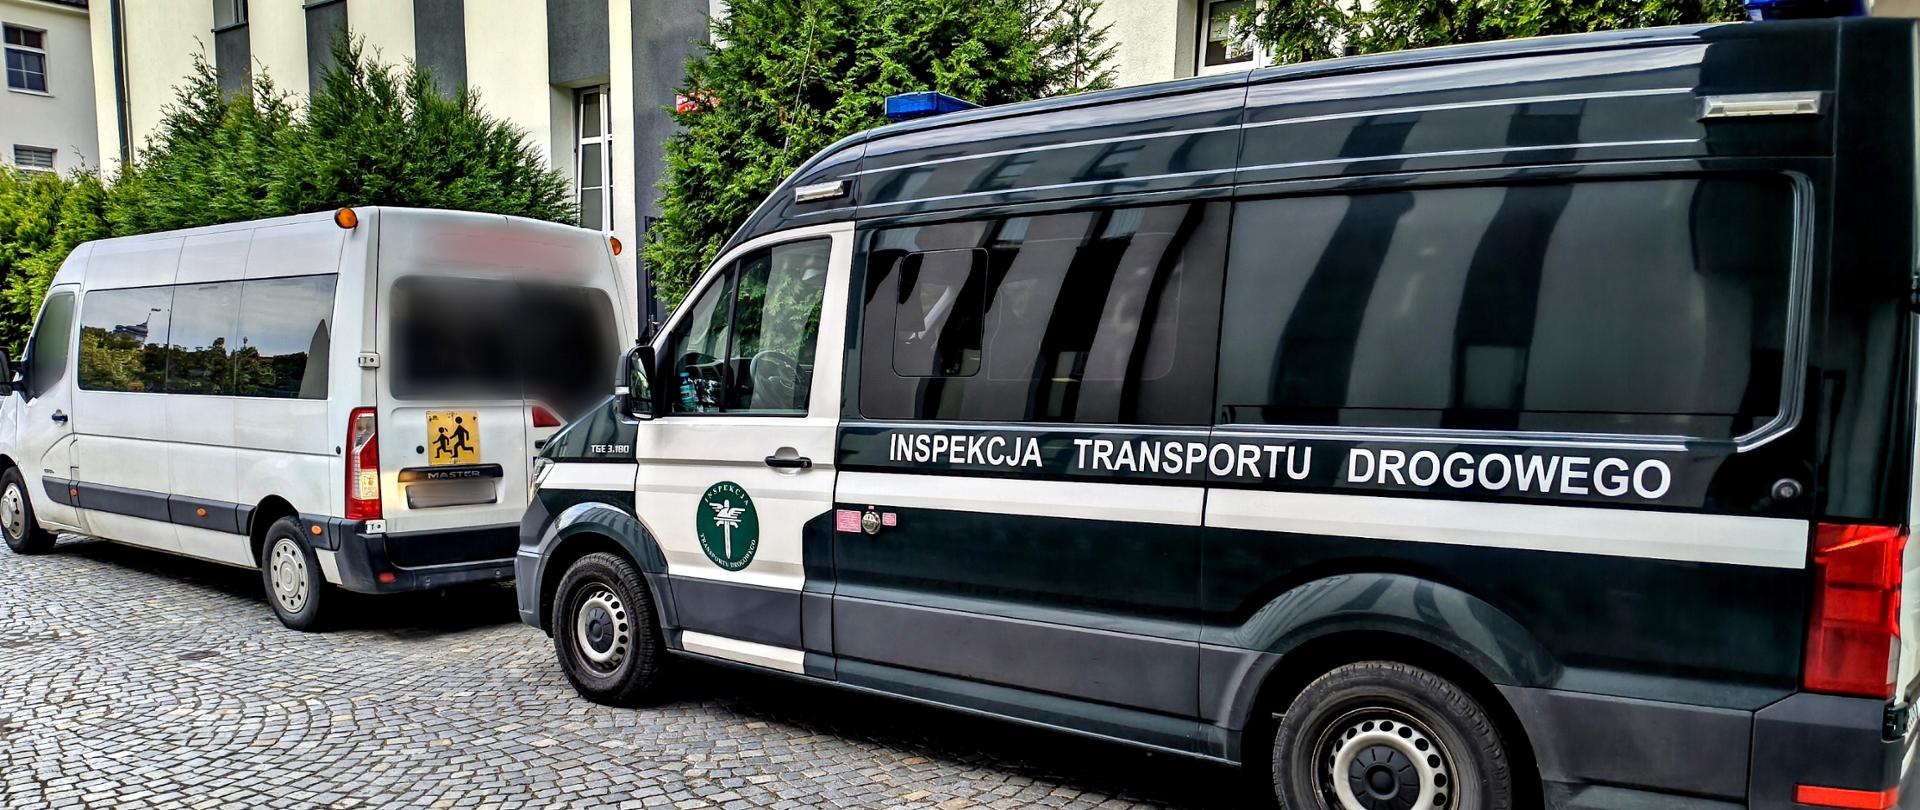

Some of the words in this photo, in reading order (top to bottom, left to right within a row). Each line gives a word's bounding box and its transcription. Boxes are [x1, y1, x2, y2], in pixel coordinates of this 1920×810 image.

[591, 444, 606, 453] TGE
[889, 433, 1043, 467] INSPEKCJA
[1073, 438, 1312, 480] TRANSPORTU
[1347, 448, 1671, 499] DROGOWEGO
[427, 469, 481, 480] MASTER
